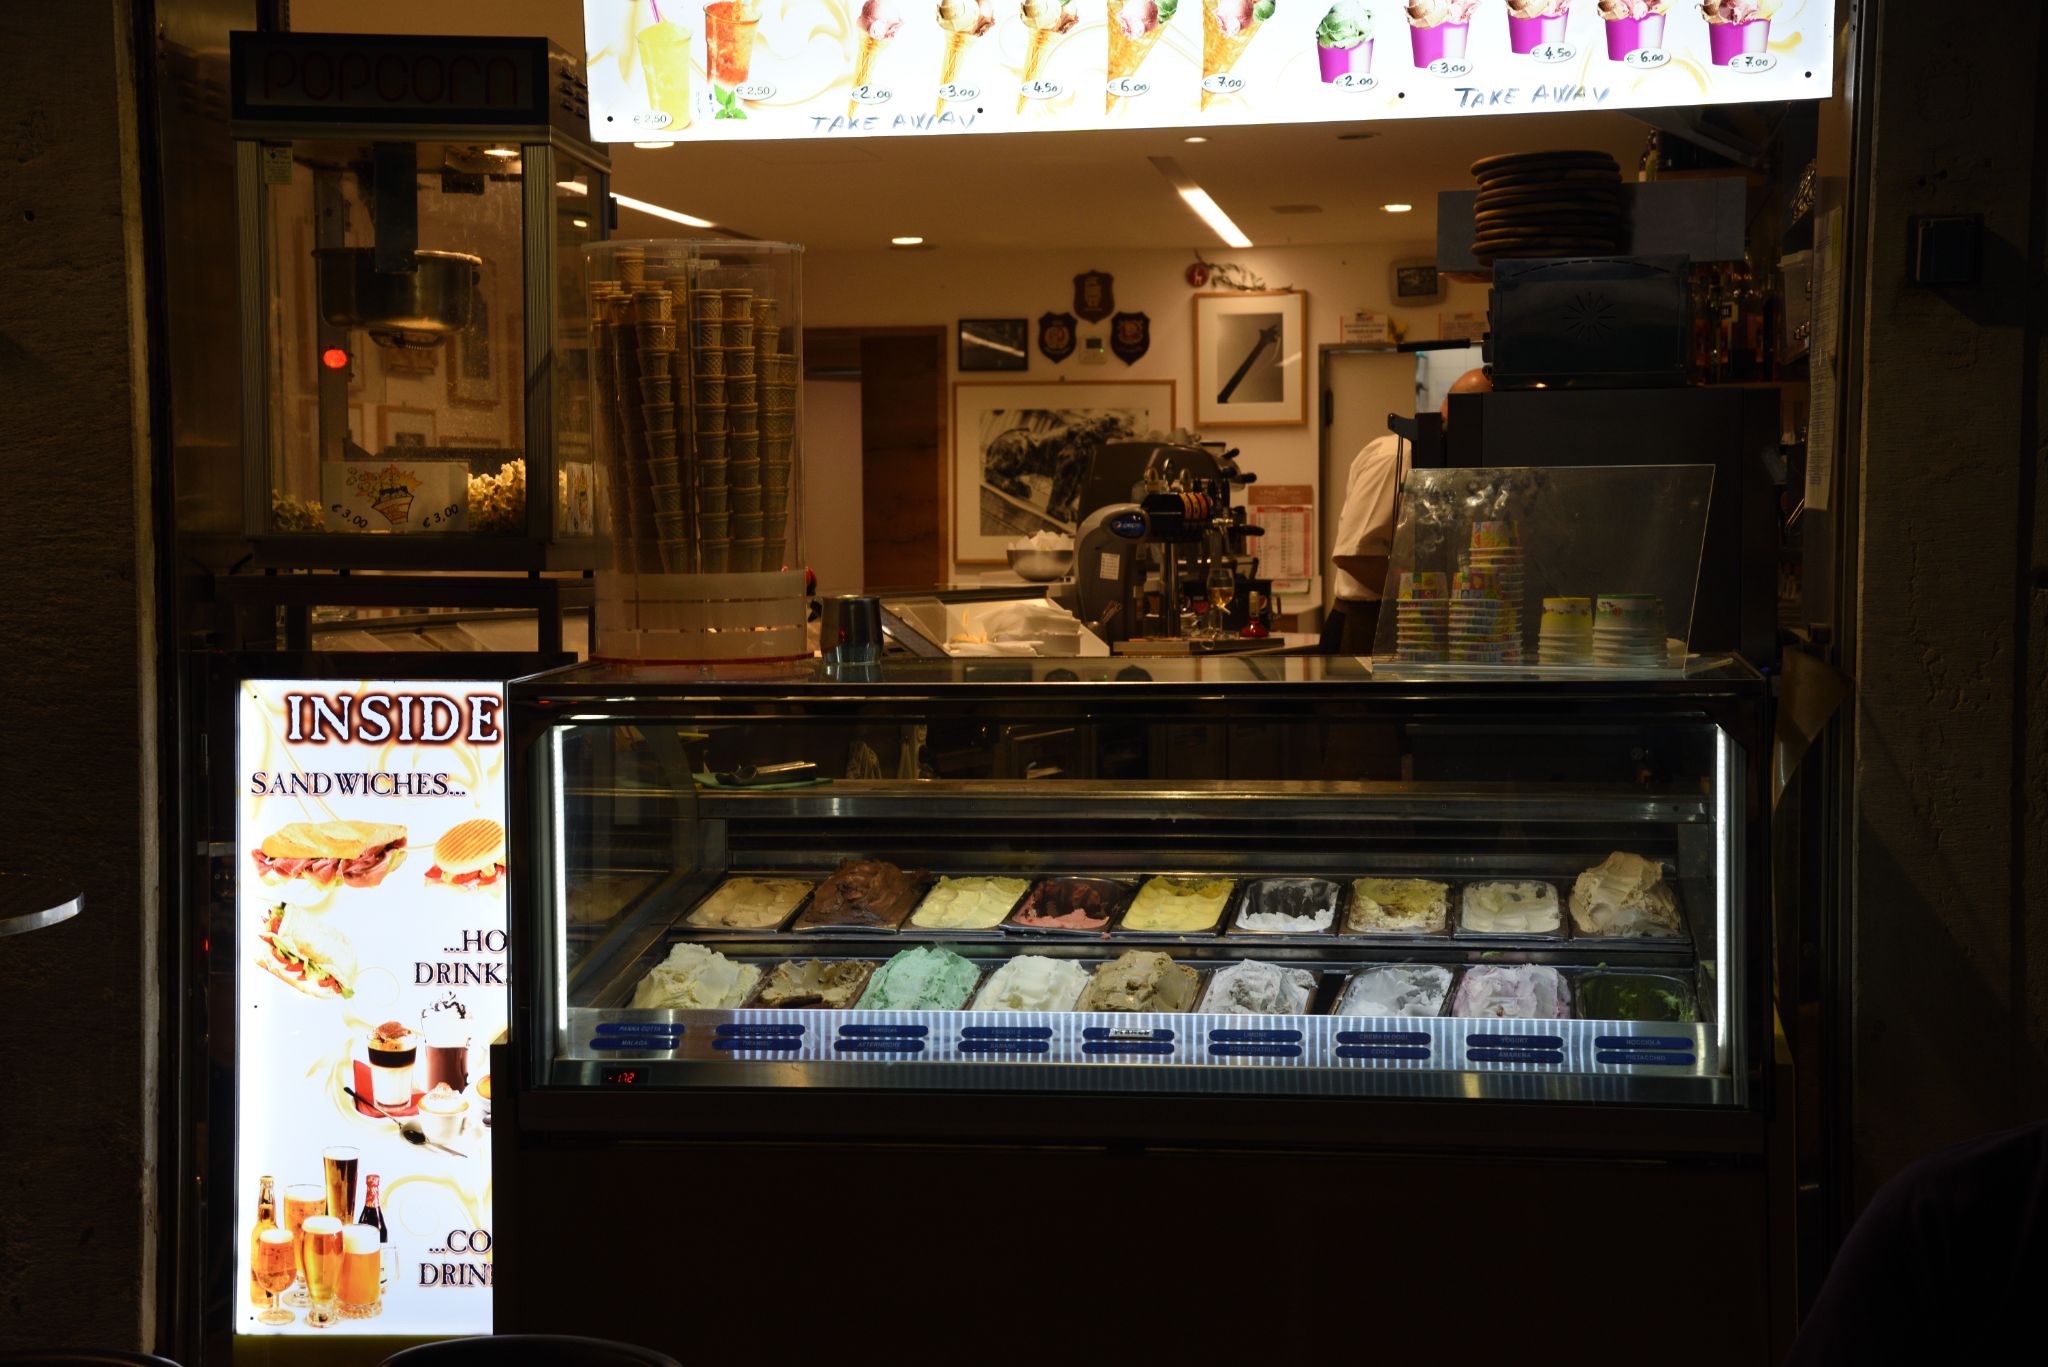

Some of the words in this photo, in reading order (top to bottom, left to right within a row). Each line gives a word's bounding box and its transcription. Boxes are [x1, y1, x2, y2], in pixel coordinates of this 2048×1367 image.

[1544, 46, 1571, 59] 4.50
[1639, 51, 1664, 63] 6.00
[1441, 62, 1466, 73] 3.00
[1745, 56, 1769, 67] 7.00
[1033, 81, 1058, 93] 4.50
[1120, 79, 1148, 92] 6.00
[1218, 76, 1242, 88] 7.00
[747, 86, 770, 97] 2,50
[1454, 87, 1520, 108] TAKE
[644, 114, 667, 124] 2,50
[810, 115, 880, 132] TAKE
[286, 693, 502, 743] INSIDE
[415, 962, 508, 985] DRINK
[419, 1263, 493, 1286] DRIN
